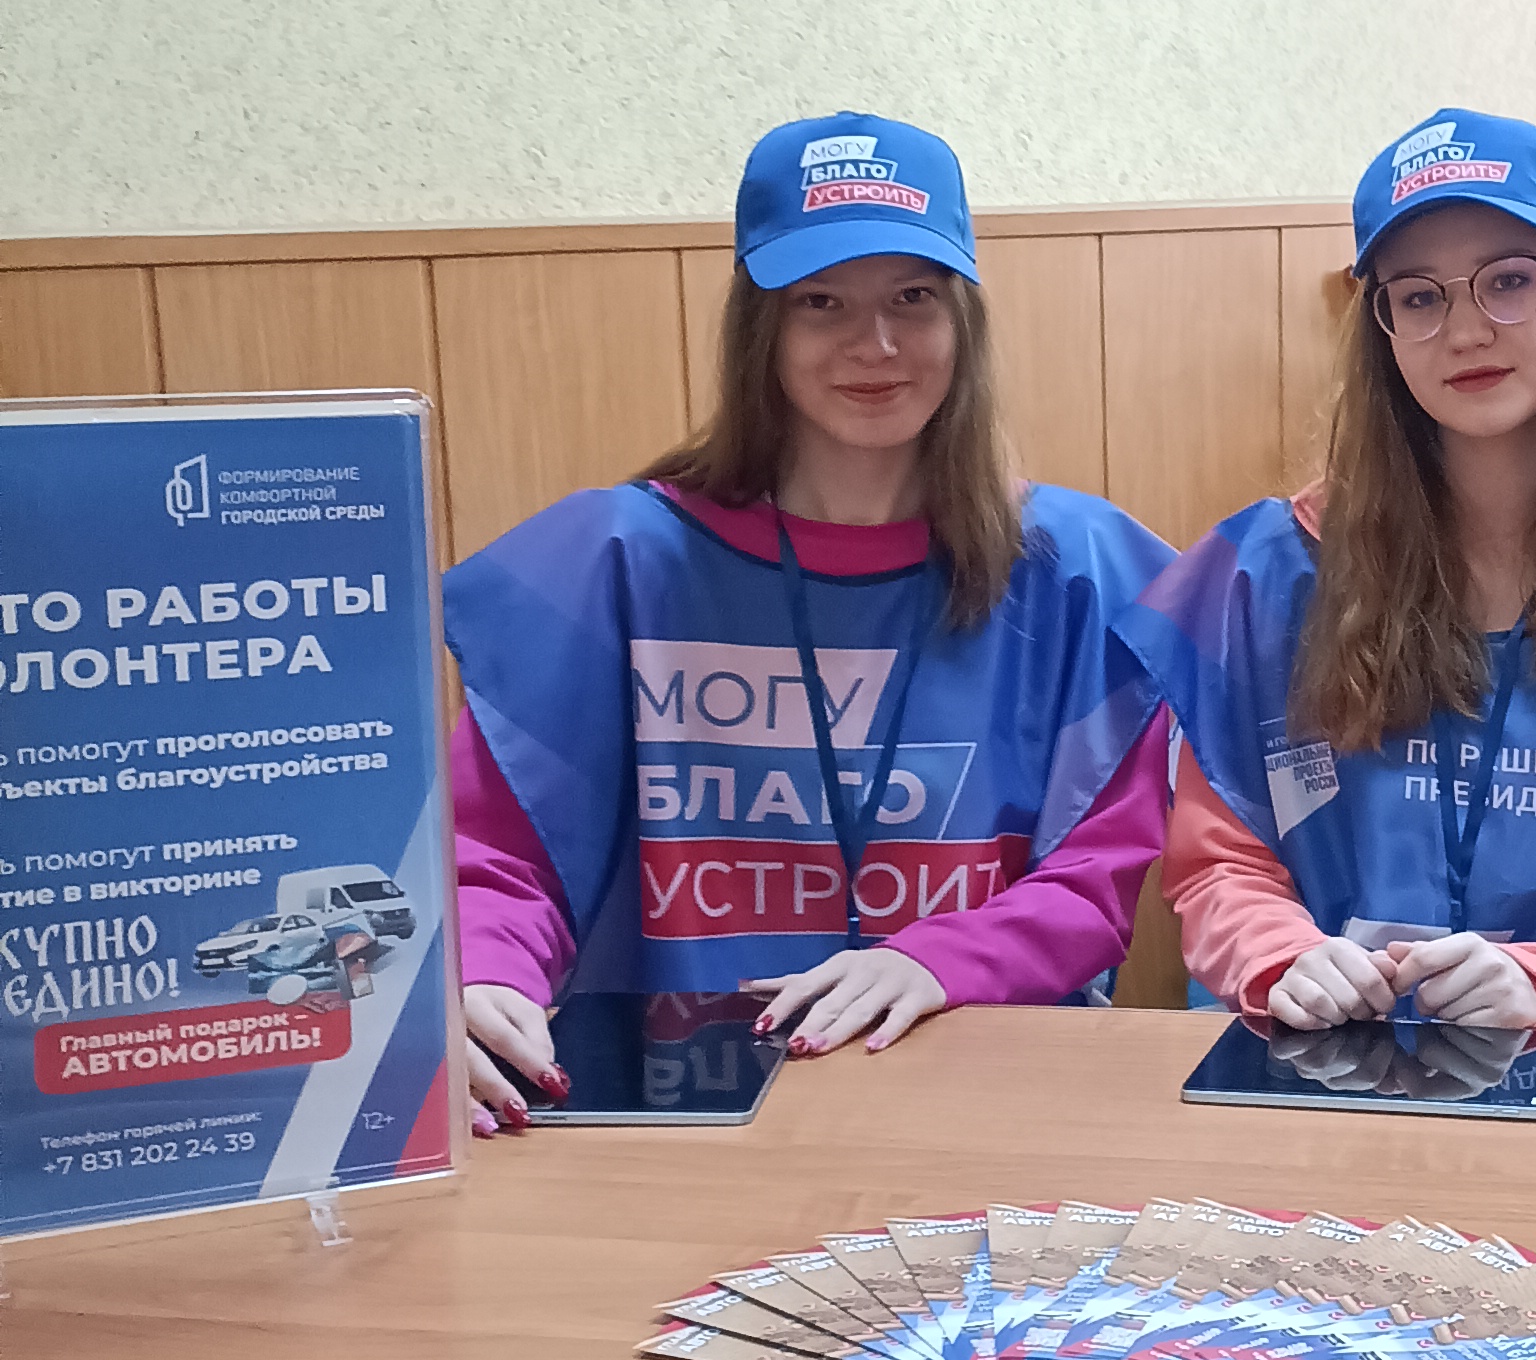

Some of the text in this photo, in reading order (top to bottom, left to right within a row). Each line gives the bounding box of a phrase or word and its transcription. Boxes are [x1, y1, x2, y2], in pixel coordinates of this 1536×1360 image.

[810, 141, 868, 160] МОГУ
[1400, 128, 1447, 156] МОГУ
[811, 162, 888, 182] БЛАГО
[1400, 163, 1502, 196] УСТРОИТЬ
[813, 184, 923, 210] УСТРОИТЬ
[218, 467, 361, 485] ФОРМИРОВАНИЕ
[219, 486, 337, 505] КОМФОРТНОЙ
[221, 504, 386, 525] ГОРОДСКОЙ СРЕДЫ
[106, 574, 387, 629] РАБОТЫ
[0, 634, 333, 693] ЛОНТЕРА
[633, 668, 865, 731] МОГУ
[17, 739, 149, 767] помогут
[156, 719, 393, 756] проголосовать
[0, 750, 388, 800] ъекты благоустройства
[25, 845, 156, 874] помогут
[163, 833, 297, 864] принять
[64, 886, 82, 902] в
[90, 867, 261, 900] викторине
[643, 859, 1006, 920] УСТРОИТ
[60, 1022, 172, 1053] Главный
[180, 1011, 289, 1041] подарок
[62, 1027, 322, 1078] АВТОМОБИЛЬ!
[41, 1126, 120, 1150] Телефон
[123, 1118, 197, 1141] горячей
[43, 1130, 256, 1176] +7 831 202 24 39
